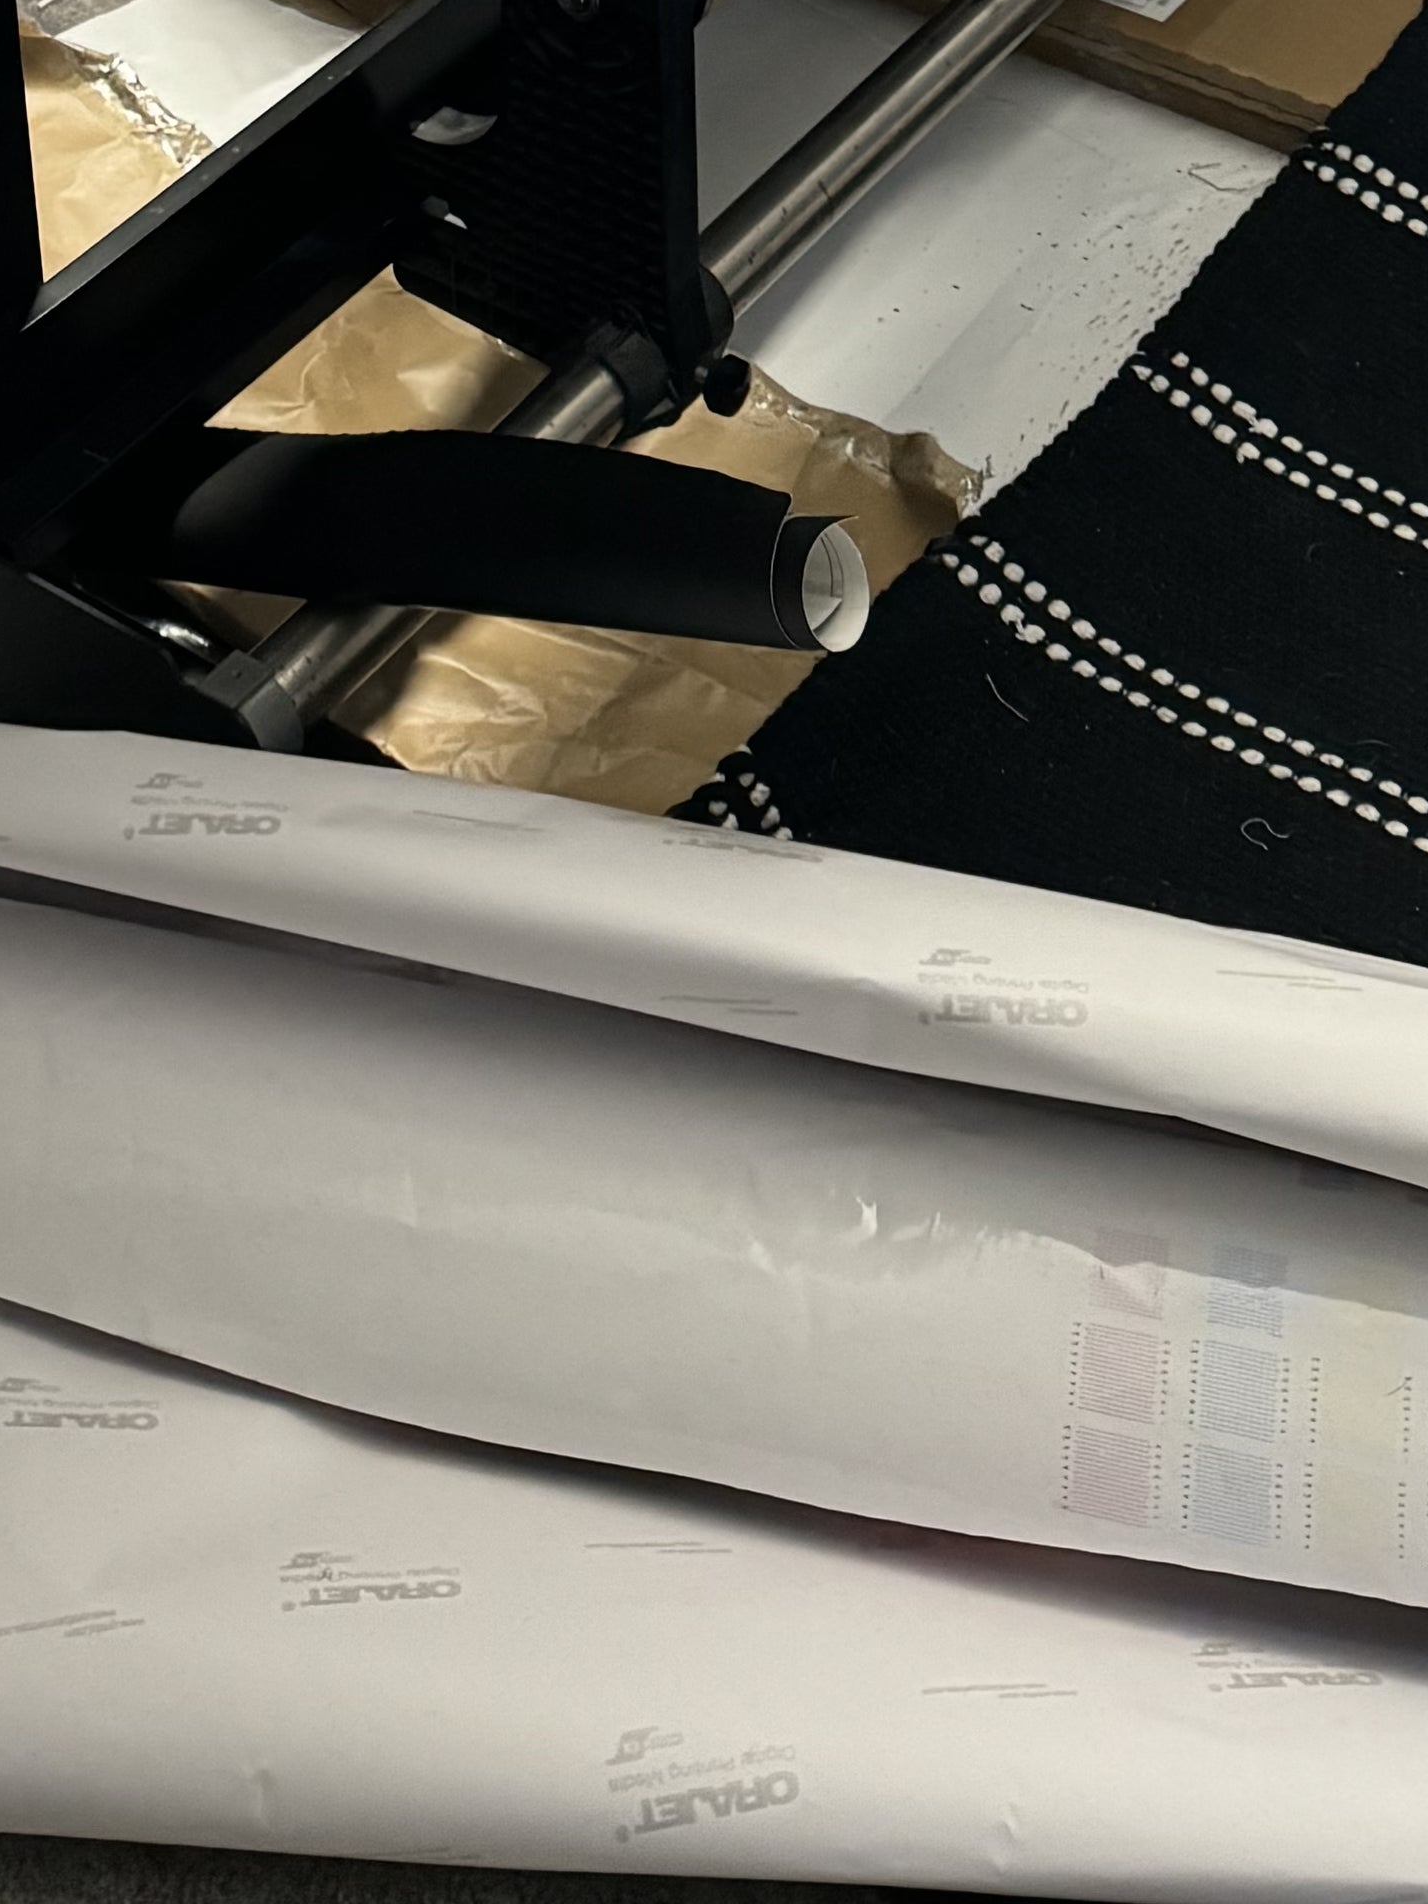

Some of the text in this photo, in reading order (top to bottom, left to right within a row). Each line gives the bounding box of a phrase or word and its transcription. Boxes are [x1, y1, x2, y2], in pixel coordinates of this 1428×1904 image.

[934, 995, 1089, 1028] ORAJET
[4, 1411, 159, 1430] ORAJET
[300, 1581, 461, 1607] ORAJET
[634, 1770, 800, 1834] ORAJET
